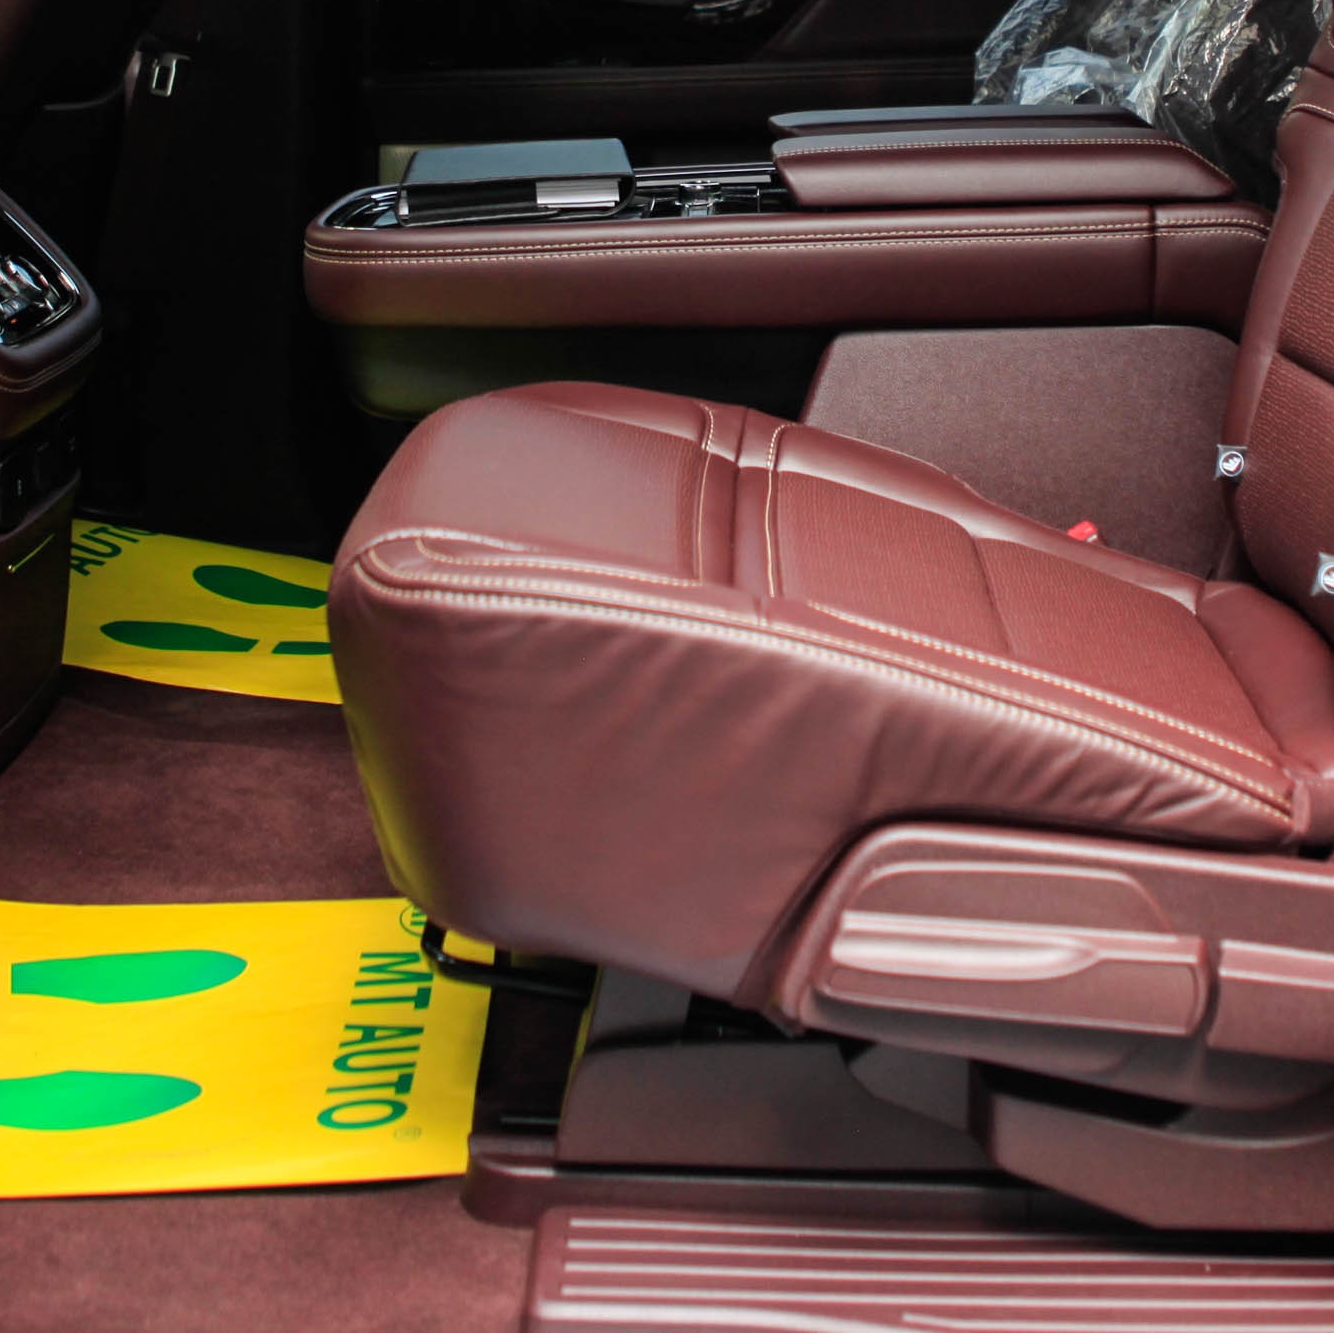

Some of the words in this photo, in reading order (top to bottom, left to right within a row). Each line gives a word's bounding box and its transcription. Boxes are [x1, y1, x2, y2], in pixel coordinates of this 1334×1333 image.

[70, 525, 157, 576] AUT
[351, 952, 434, 1010] MT
[317, 1024, 424, 1130] AUTO
